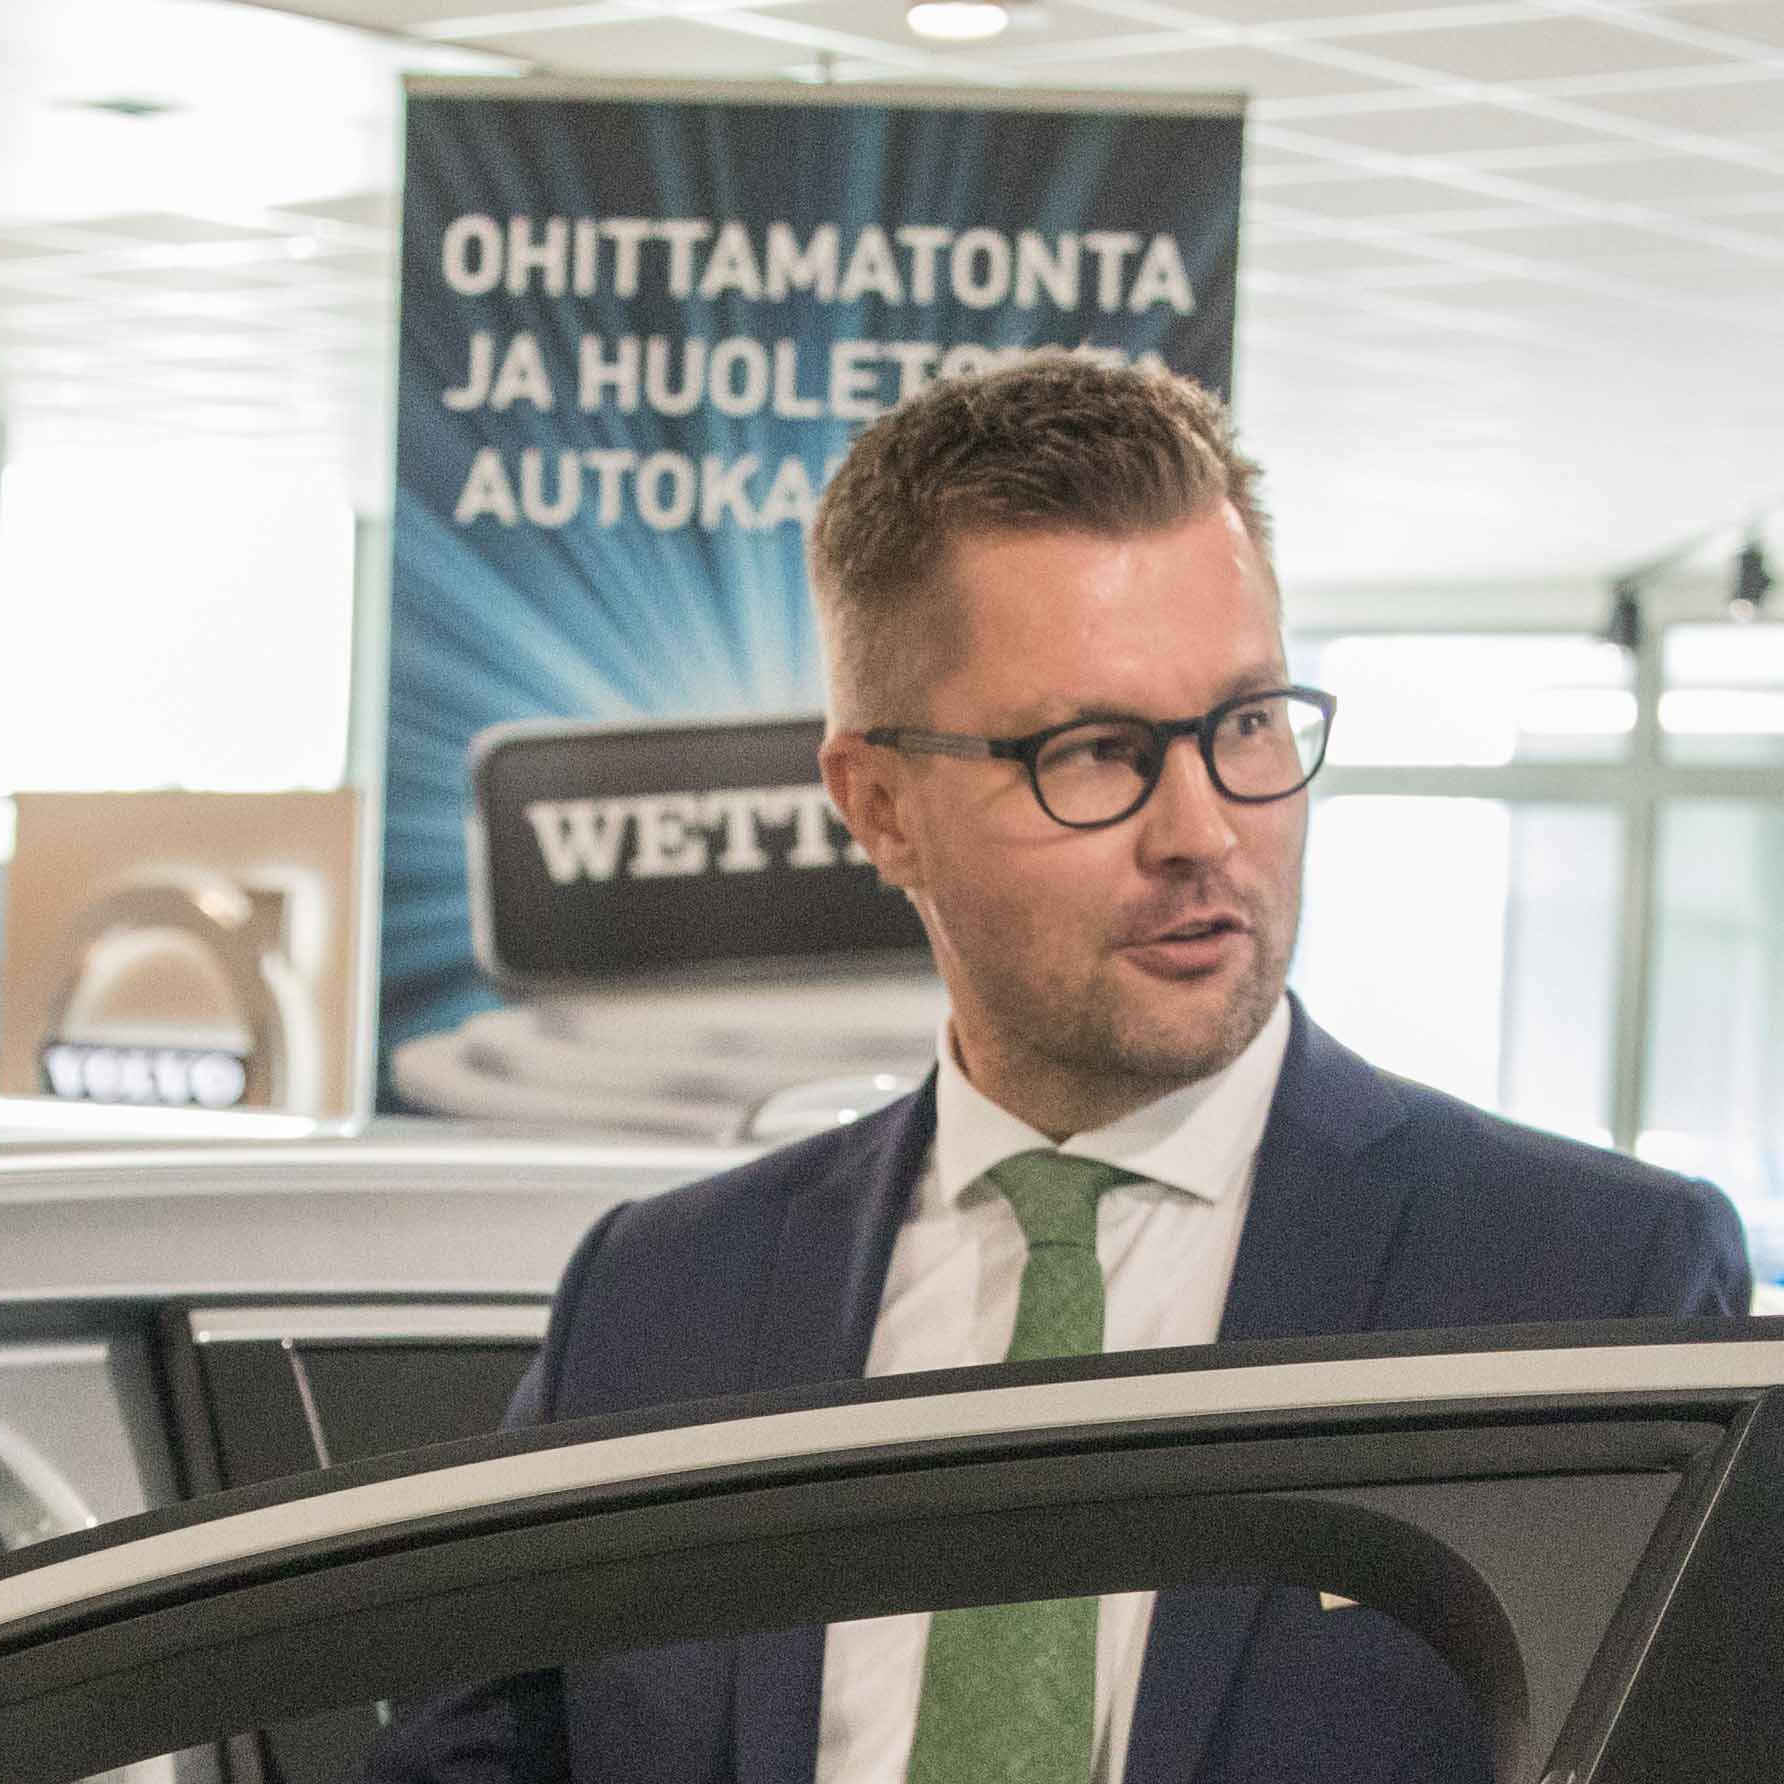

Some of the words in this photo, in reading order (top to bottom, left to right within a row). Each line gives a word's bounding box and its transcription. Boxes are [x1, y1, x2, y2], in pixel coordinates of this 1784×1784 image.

[444, 214, 1196, 313] OHITTAMATONTA
[445, 334, 552, 414] JA
[528, 784, 871, 883] WETT
